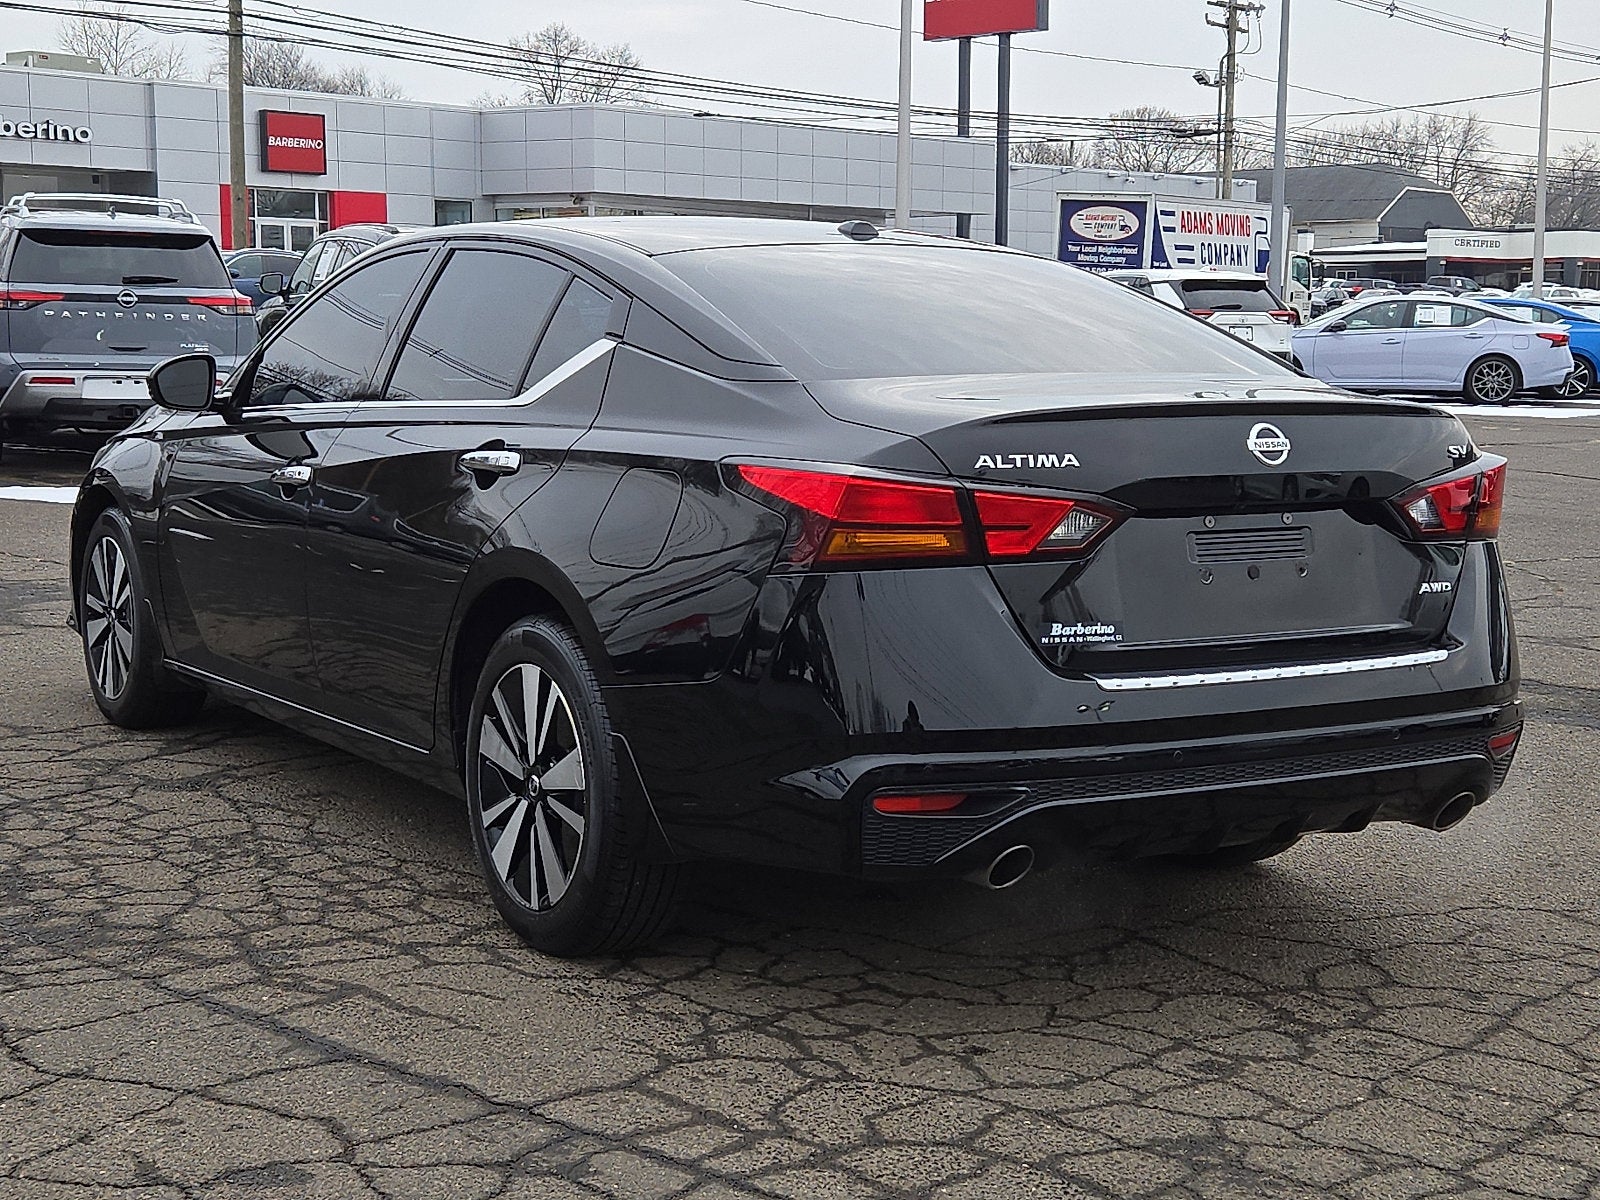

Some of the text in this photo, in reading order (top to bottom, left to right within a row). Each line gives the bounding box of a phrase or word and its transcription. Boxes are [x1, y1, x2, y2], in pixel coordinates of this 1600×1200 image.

[268, 135, 324, 150] BARBERINO
[1180, 210, 1251, 238] ADAMS MOVING
[1454, 238, 1501, 248] CERTIFIED
[1067, 244, 1138, 255] Your Local Neighborhood
[1200, 241, 1249, 267] COMPANY
[1077, 253, 1127, 264] Moving Company
[44, 310, 207, 322] PATHFINDER
[1253, 441, 1288, 449] NISSAN
[1448, 445, 1467, 457] SV
[974, 453, 1080, 469] ALTIMA
[1419, 582, 1452, 594] AWD
[1050, 622, 1115, 636] Barberino
[1041, 636, 1084, 644] NISSAN
